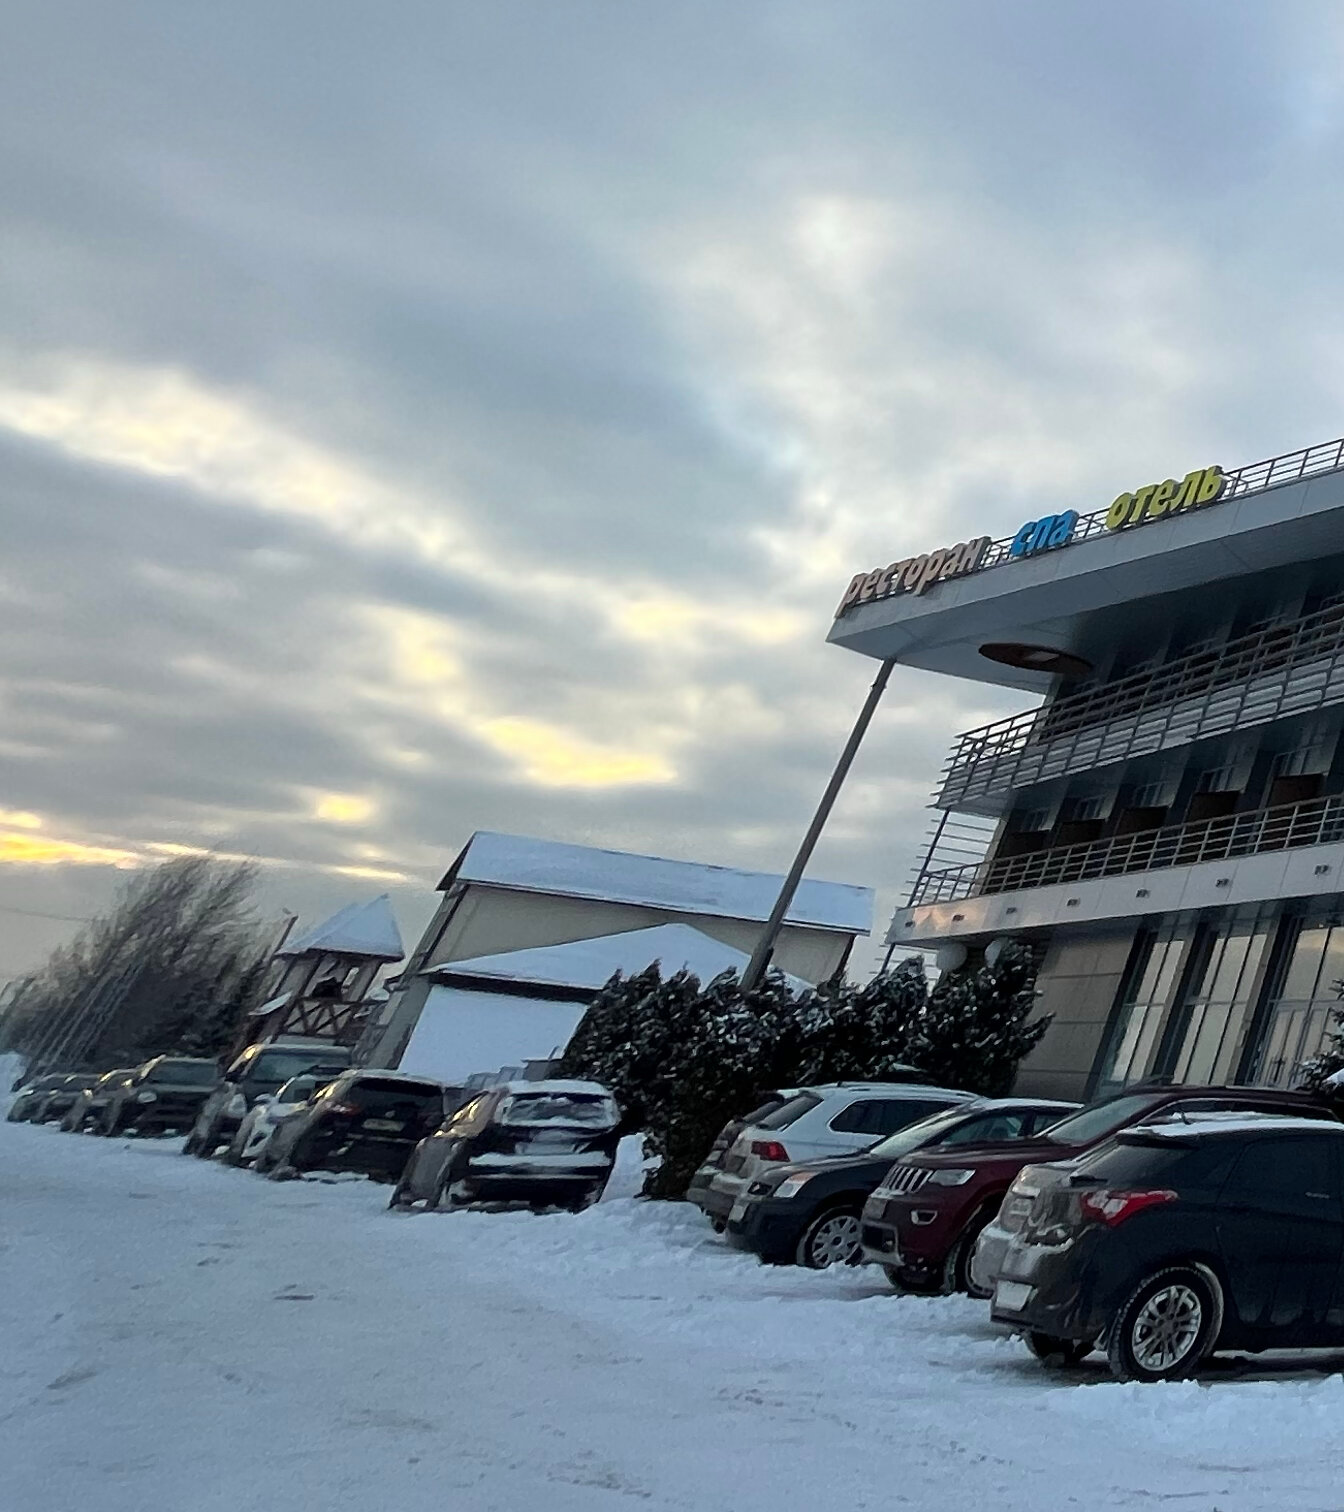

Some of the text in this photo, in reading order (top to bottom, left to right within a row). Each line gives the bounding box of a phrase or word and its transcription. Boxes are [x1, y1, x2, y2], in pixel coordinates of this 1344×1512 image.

[835, 465, 1224, 618] ресторан спа отель
